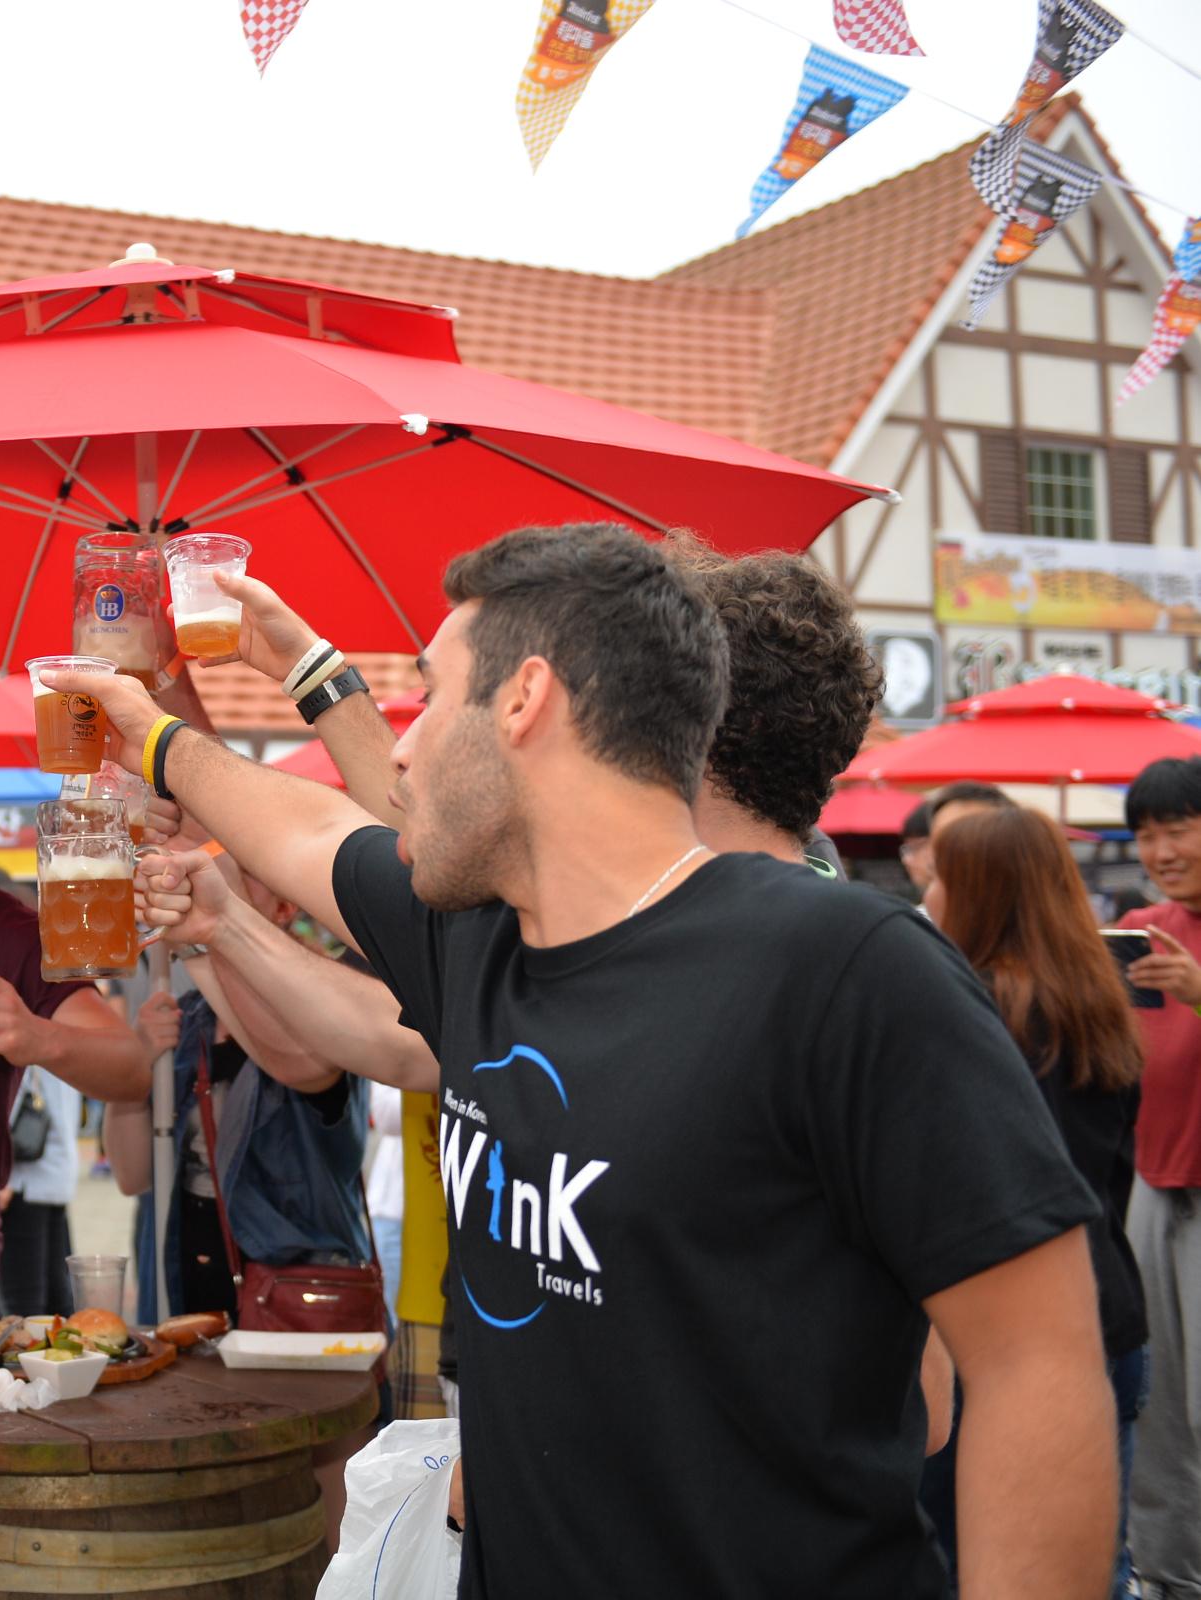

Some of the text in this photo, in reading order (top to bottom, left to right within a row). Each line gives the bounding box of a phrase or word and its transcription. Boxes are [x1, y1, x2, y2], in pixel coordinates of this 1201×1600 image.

[100, 602, 119, 617] HB
[457, 1098, 467, 1115] in
[536, 1262, 603, 1306] Travels
